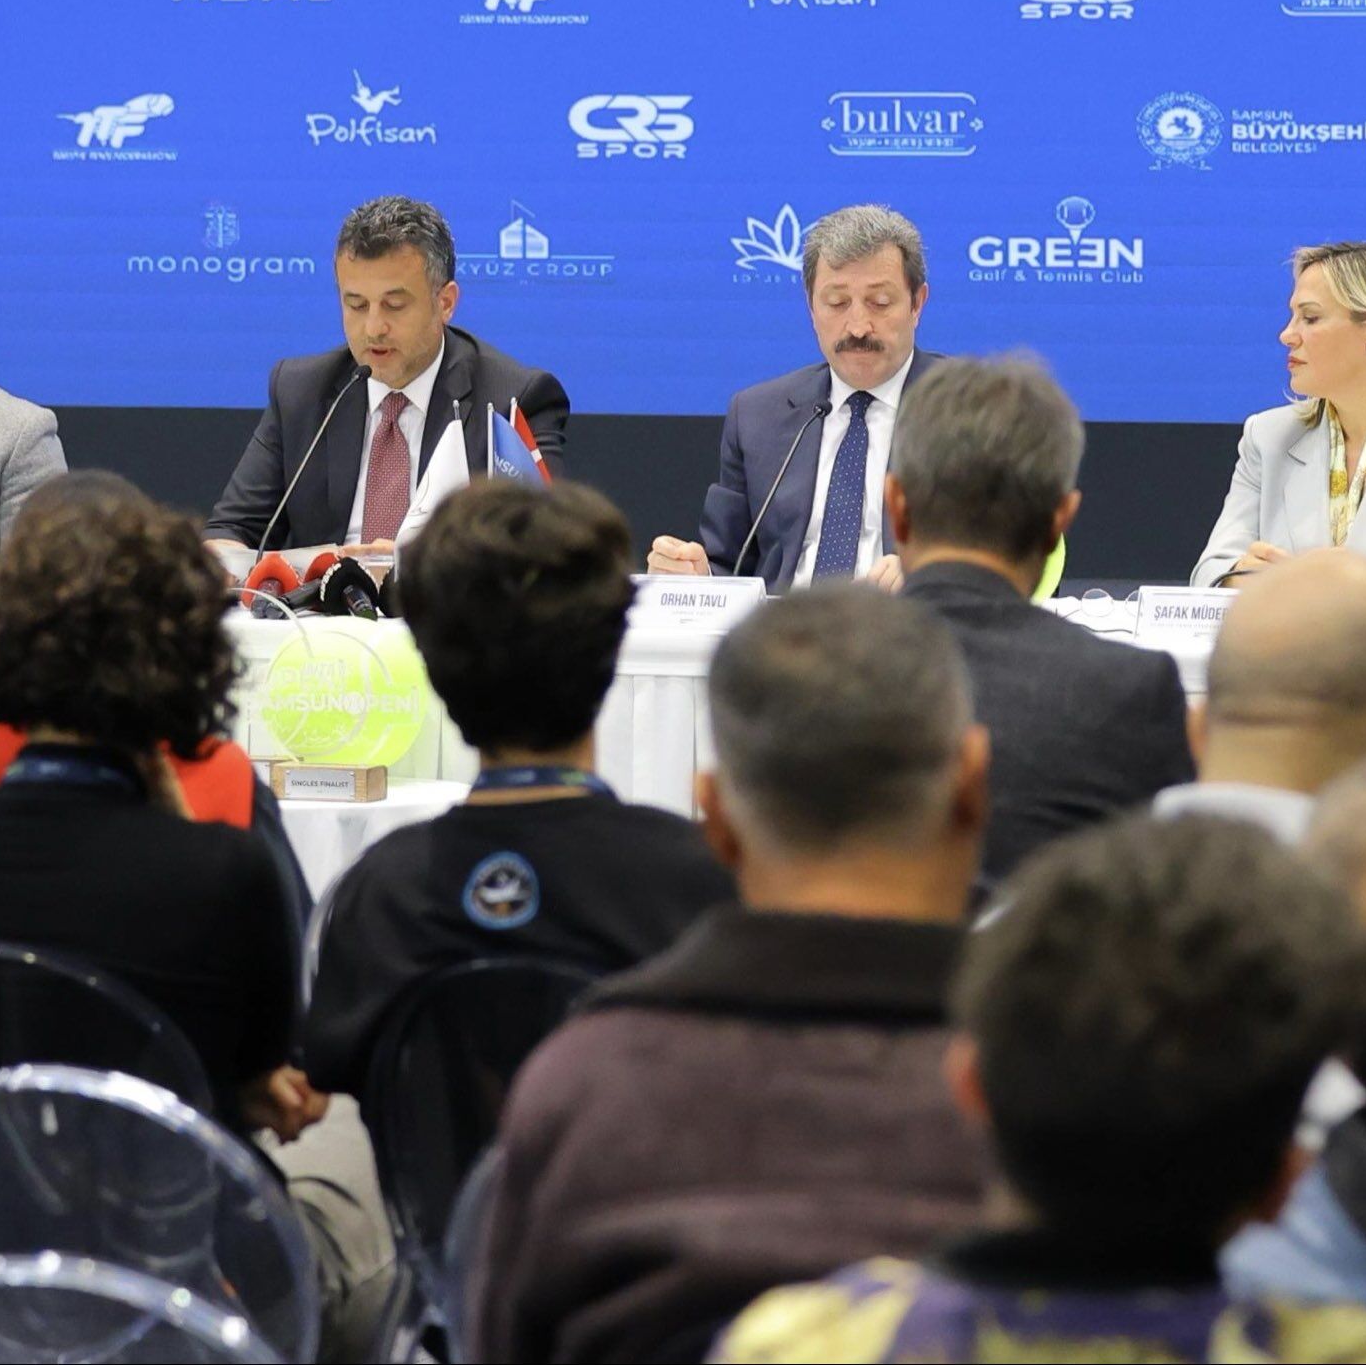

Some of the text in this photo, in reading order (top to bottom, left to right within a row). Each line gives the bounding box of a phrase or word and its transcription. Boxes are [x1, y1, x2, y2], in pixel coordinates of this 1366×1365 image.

[1020, 3, 1133, 19] SPOR
[842, 99, 966, 134] bulvar
[1232, 110, 1293, 120] SAMSUN
[306, 112, 436, 145] Polfisan
[577, 141, 686, 158] SPOR
[969, 236, 1143, 268] GREEN
[128, 256, 314, 282] monogram
[1014, 270, 1026, 281] &
[660, 593, 727, 608] ORHAN TAVLI
[1154, 605, 1189, 621] ŞAFAK
[291, 780, 349, 788] SINGLES FINALIST
